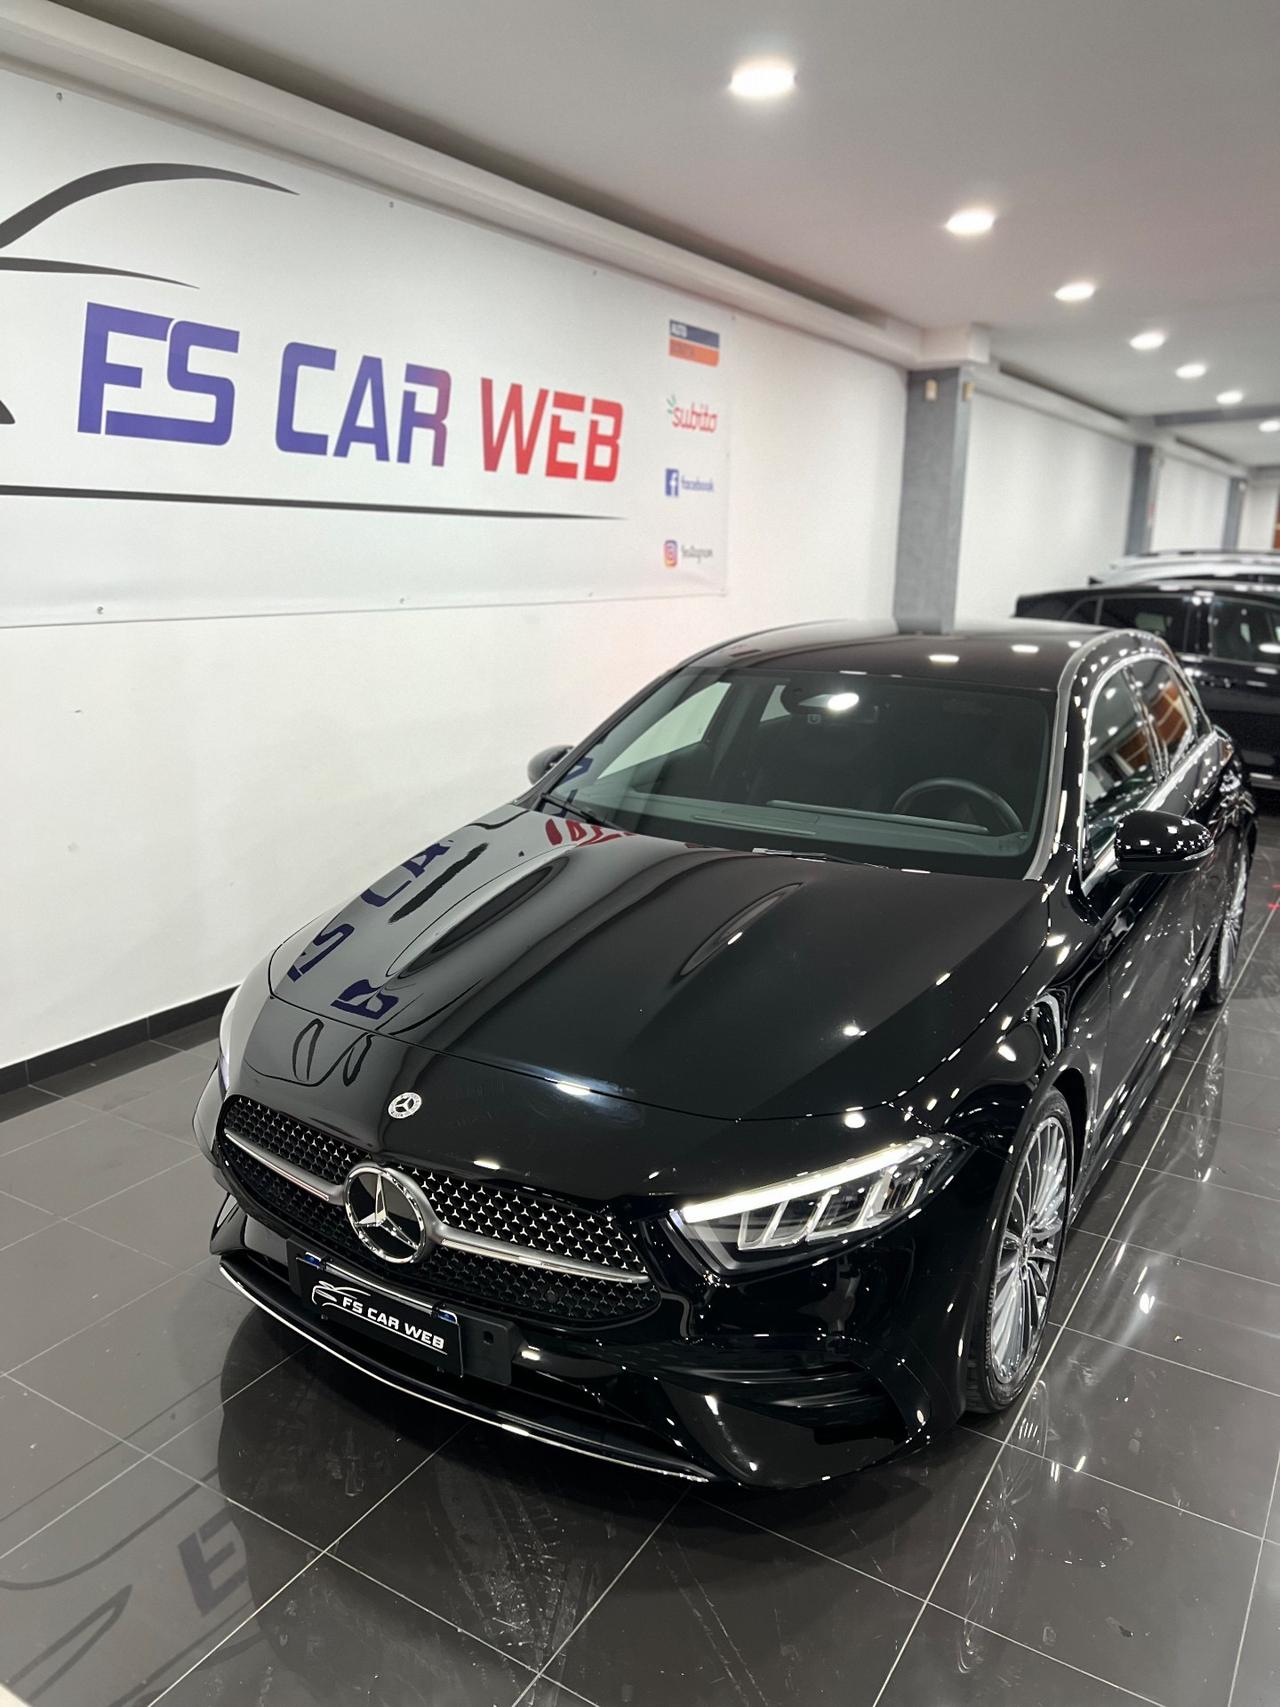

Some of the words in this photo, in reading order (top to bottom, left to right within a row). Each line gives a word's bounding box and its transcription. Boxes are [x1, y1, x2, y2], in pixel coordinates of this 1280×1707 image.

[275, 342, 451, 467] CAR
[480, 377, 624, 483] WEB
[343, 1297, 363, 1313] FS
[368, 1308, 399, 1329] CAR
[405, 1323, 444, 1348] WEB
